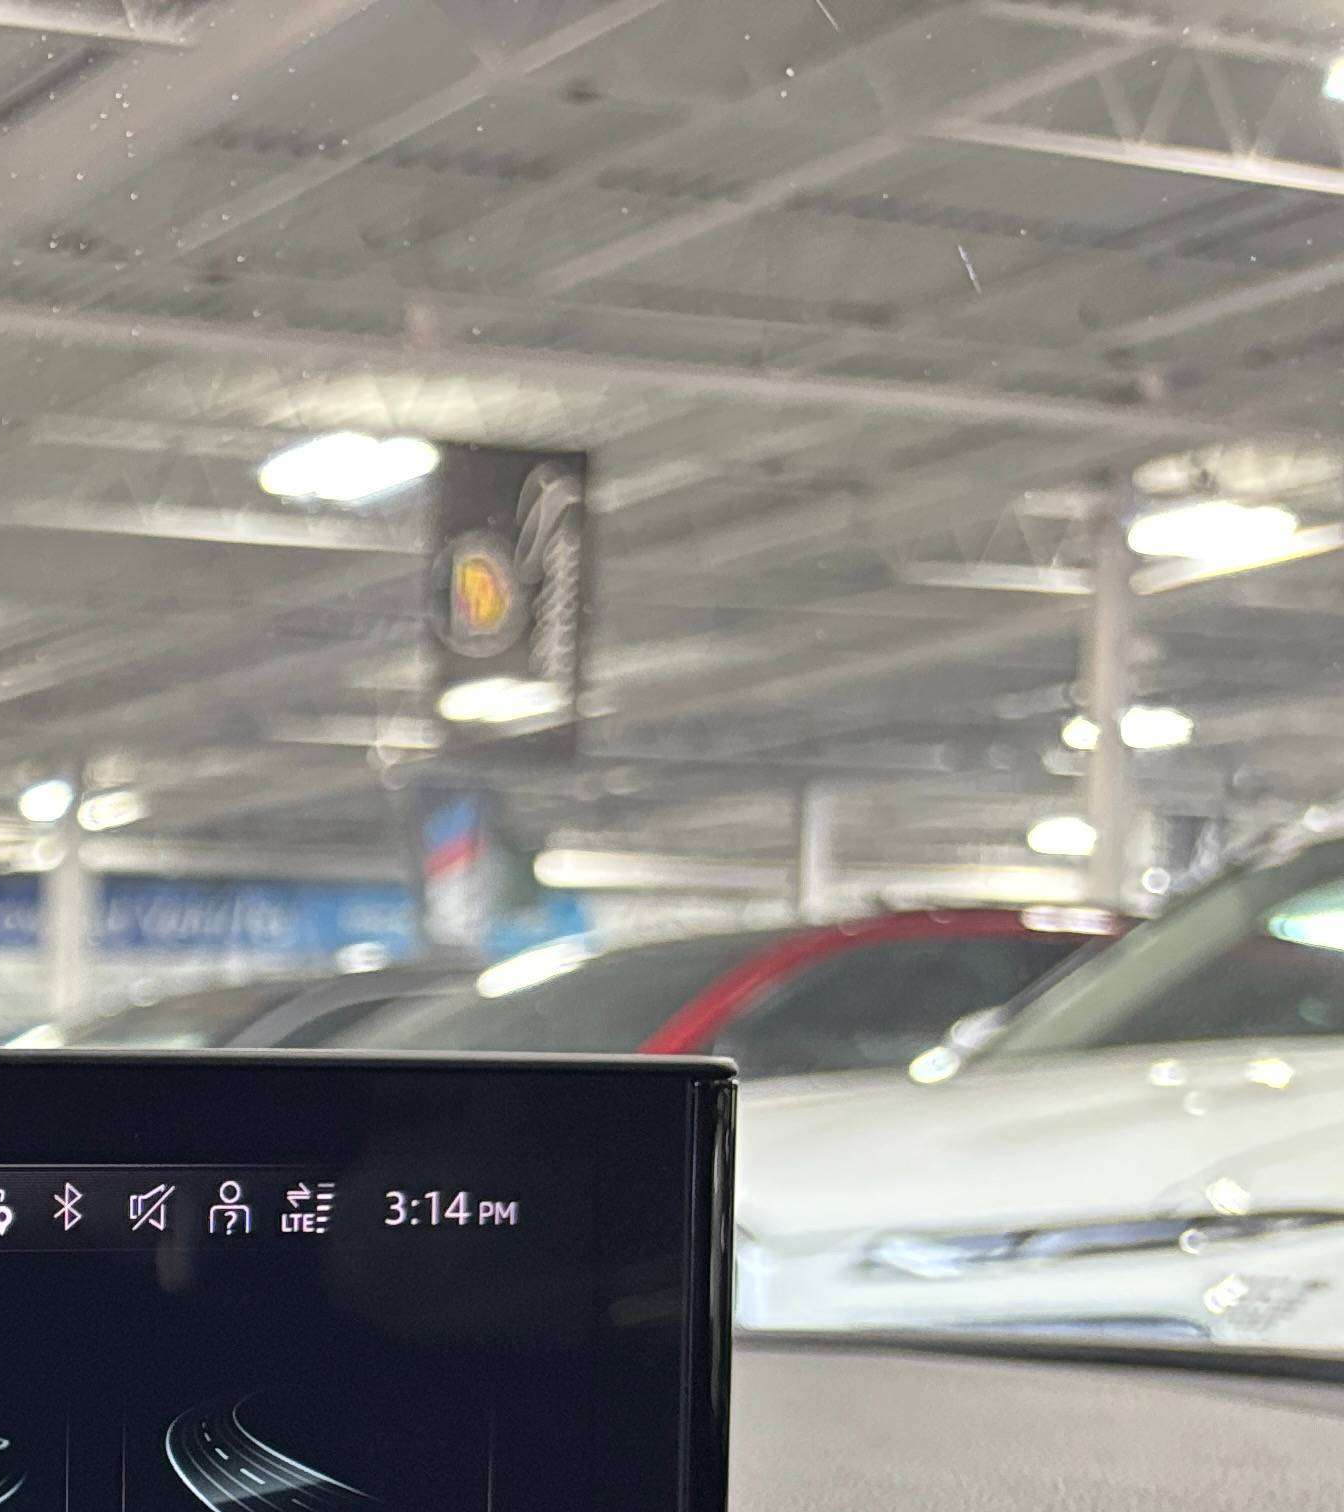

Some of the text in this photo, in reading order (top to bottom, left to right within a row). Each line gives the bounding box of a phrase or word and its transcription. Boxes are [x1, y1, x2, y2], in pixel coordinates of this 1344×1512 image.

[385, 1190, 518, 1226] 3:14 PM
[282, 1212, 313, 1233] LTE
